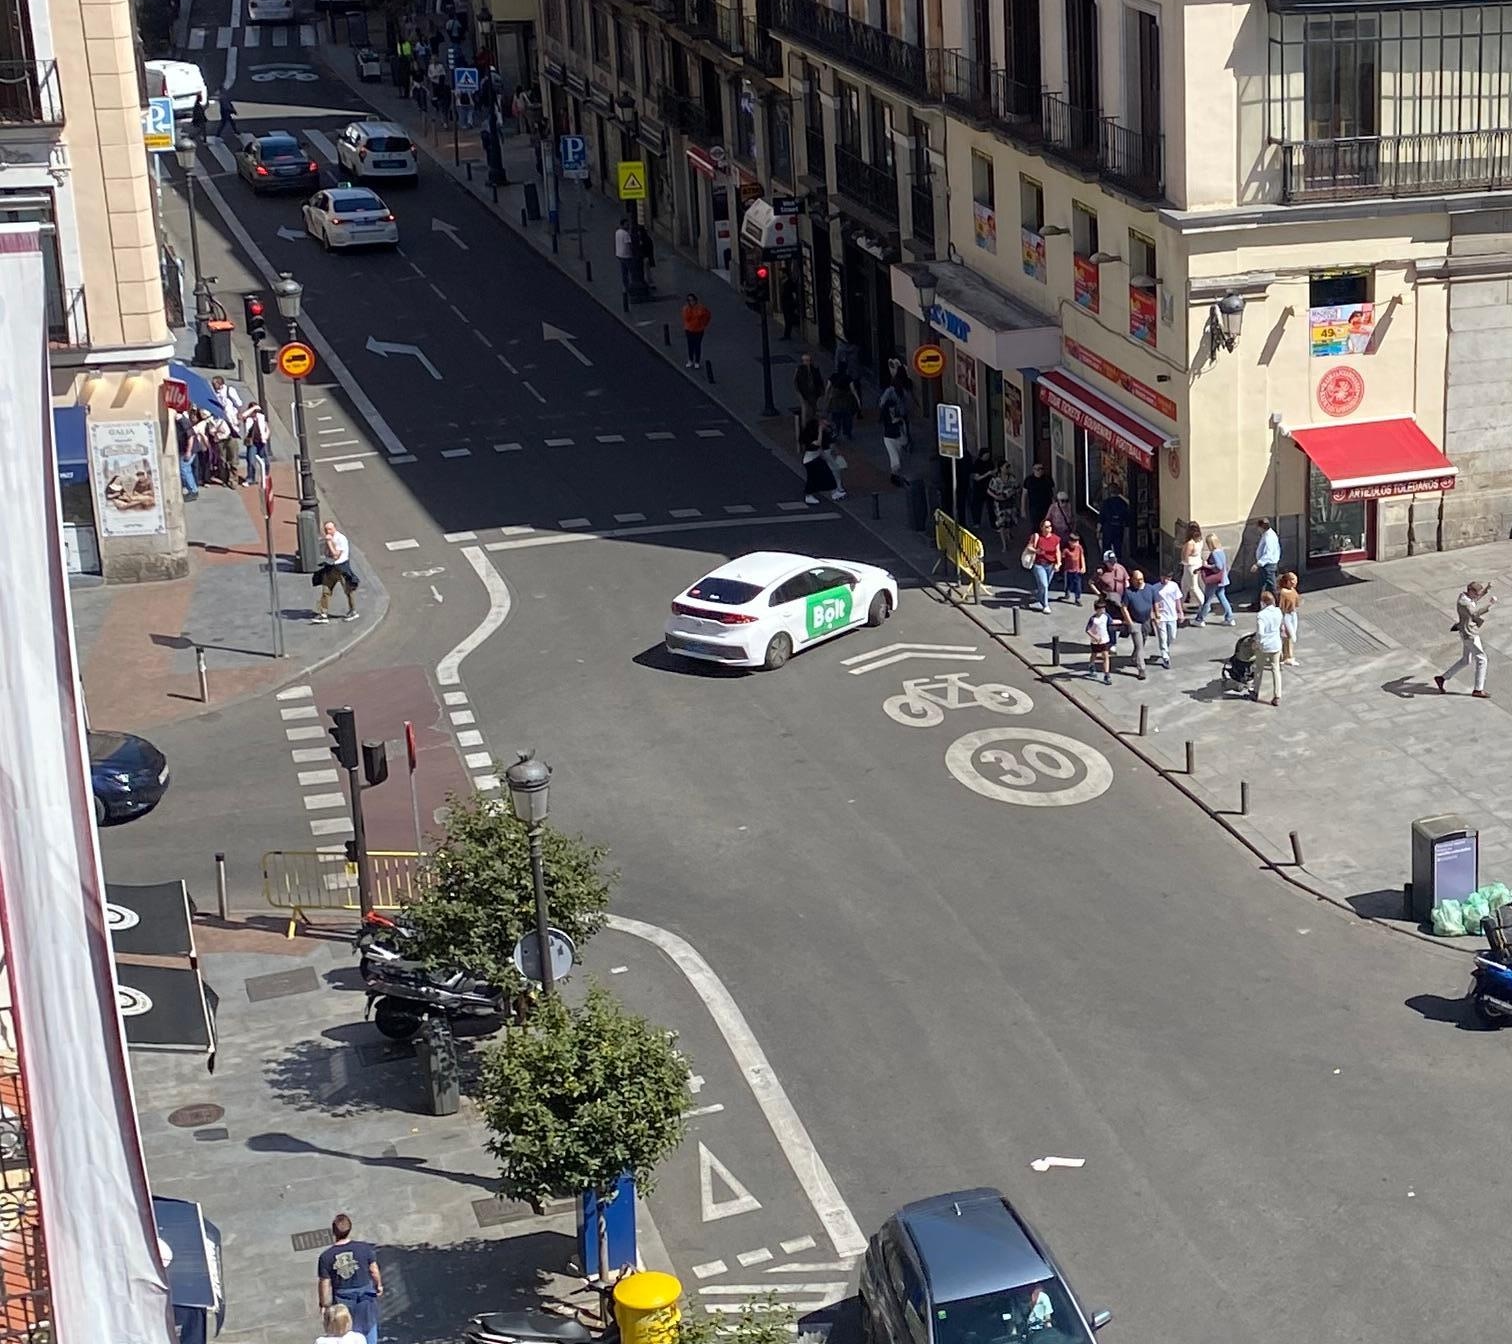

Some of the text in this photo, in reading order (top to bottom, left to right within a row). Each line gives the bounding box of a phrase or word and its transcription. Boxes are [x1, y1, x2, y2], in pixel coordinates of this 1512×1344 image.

[564, 137, 584, 162] P
[165, 384, 187, 405] illy
[813, 598, 846, 629] Bolt
[980, 743, 1077, 787] 30
